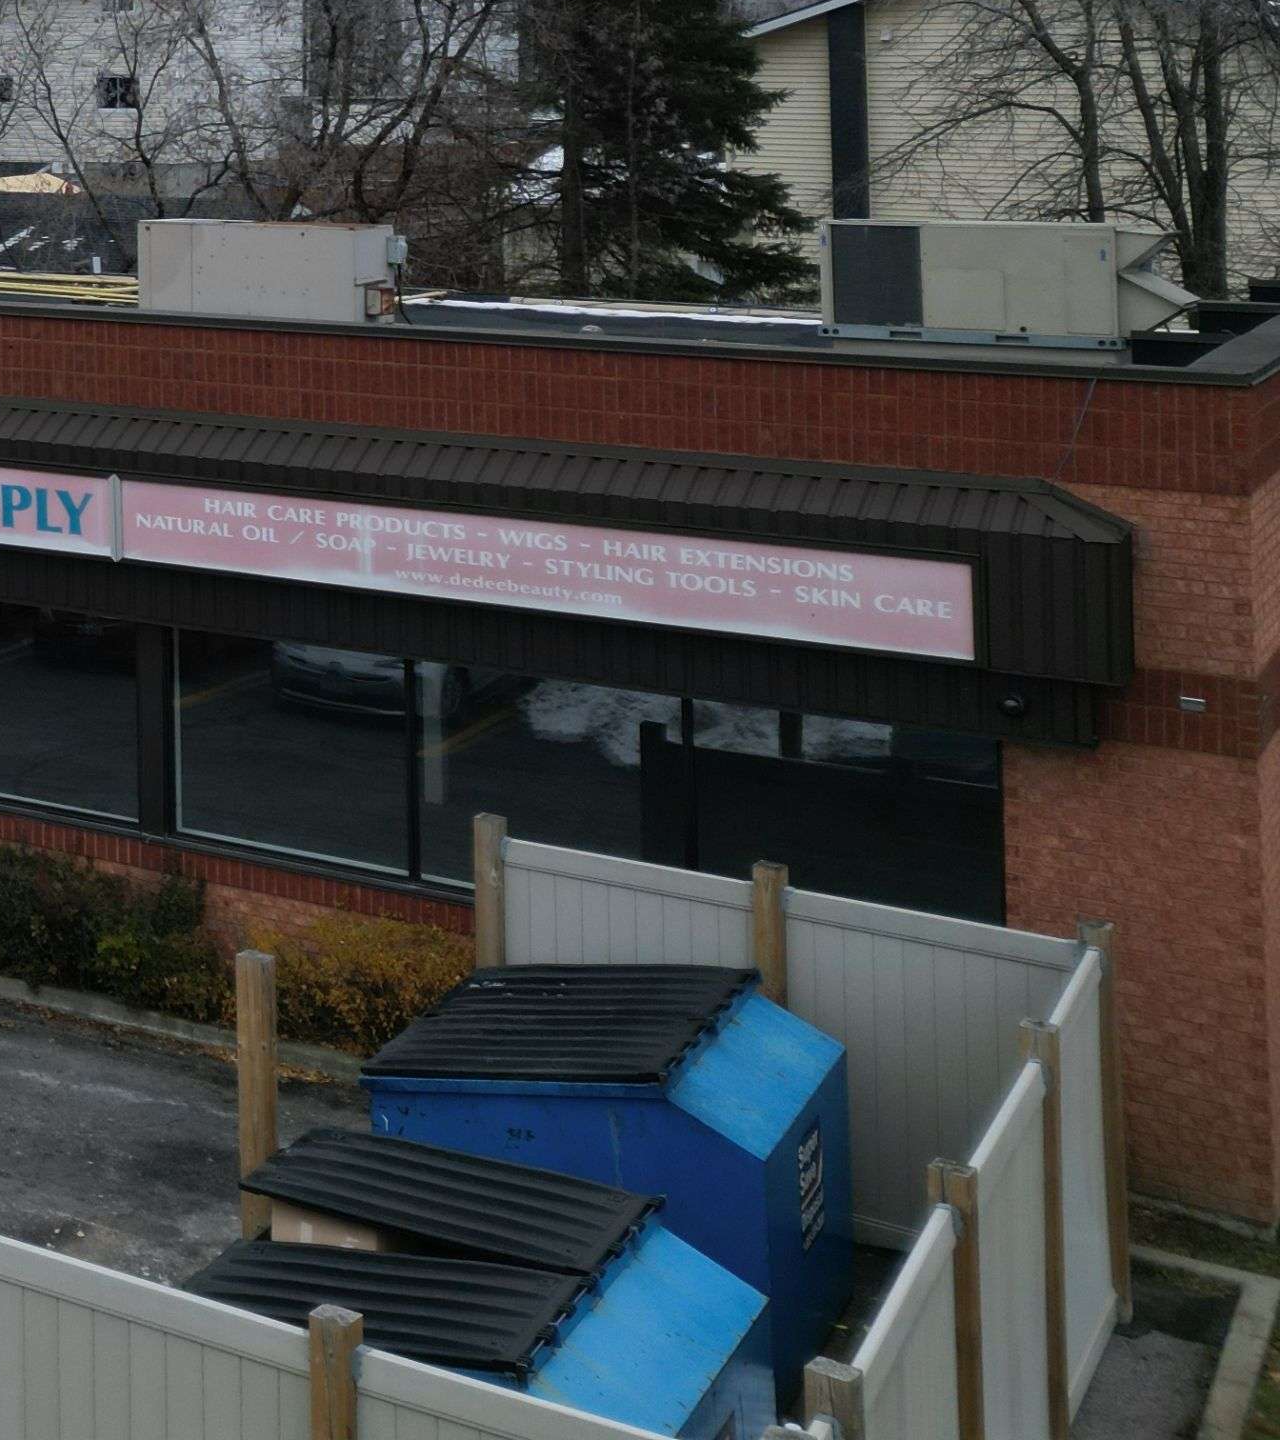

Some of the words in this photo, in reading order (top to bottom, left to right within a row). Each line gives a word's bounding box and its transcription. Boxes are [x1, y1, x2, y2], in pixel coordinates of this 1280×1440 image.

[135, 513, 233, 538] NATURAL
[242, 524, 279, 543] OIL
[315, 532, 376, 554] SOAP
[406, 543, 511, 569] JEWELRY
[545, 559, 655, 587] STYLING
[666, 570, 757, 597] TOOLS
[794, 585, 861, 608] SKIN
[874, 594, 953, 620] CARE
[204, 497, 257, 520] HAIR
[267, 505, 326, 526] CARE
[336, 511, 466, 540] PRODUCTS
[497, 528, 567, 552] WIGS
[603, 539, 667, 562] HAIR
[680, 548, 854, 583] EXTENSIONS
[394, 567, 622, 606] www.dedeebeauty.com
